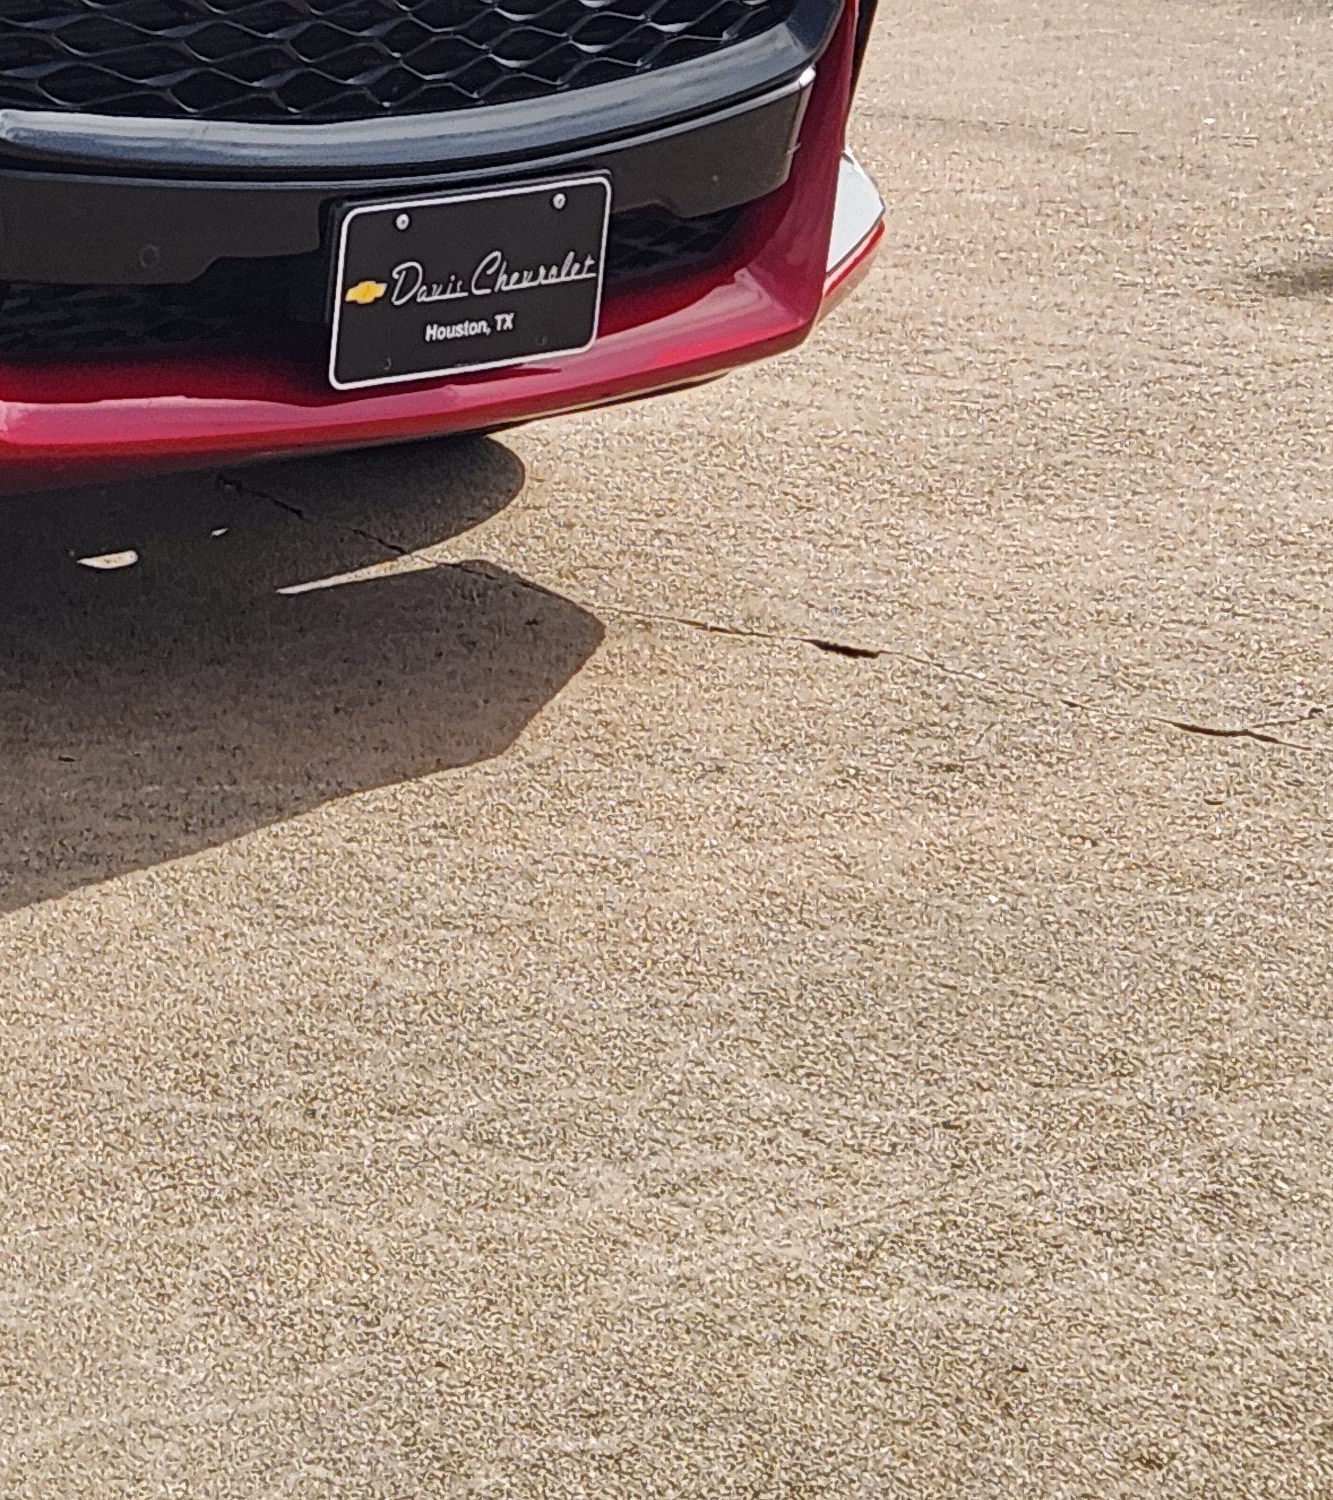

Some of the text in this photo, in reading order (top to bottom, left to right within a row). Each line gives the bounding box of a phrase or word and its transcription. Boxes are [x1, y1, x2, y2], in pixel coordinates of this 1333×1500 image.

[391, 251, 596, 305] Davis Chevrolet
[425, 313, 515, 342] Houston, TX
